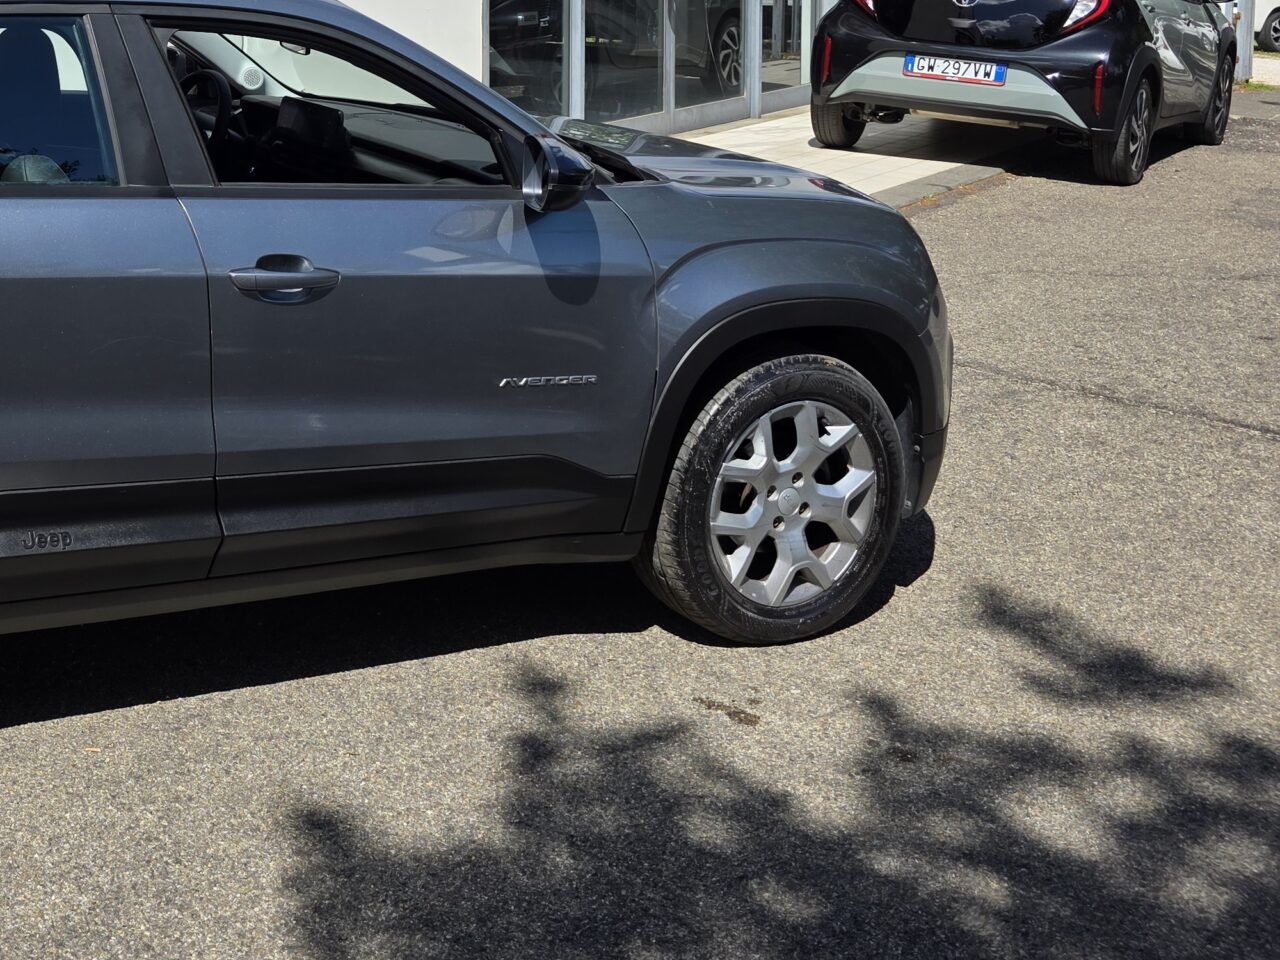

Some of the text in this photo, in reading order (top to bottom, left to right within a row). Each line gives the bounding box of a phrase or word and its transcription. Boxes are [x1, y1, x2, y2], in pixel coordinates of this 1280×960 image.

[917, 57, 937, 73] GW
[499, 374, 598, 387] AVENGER
[20, 529, 73, 551] Jeep
